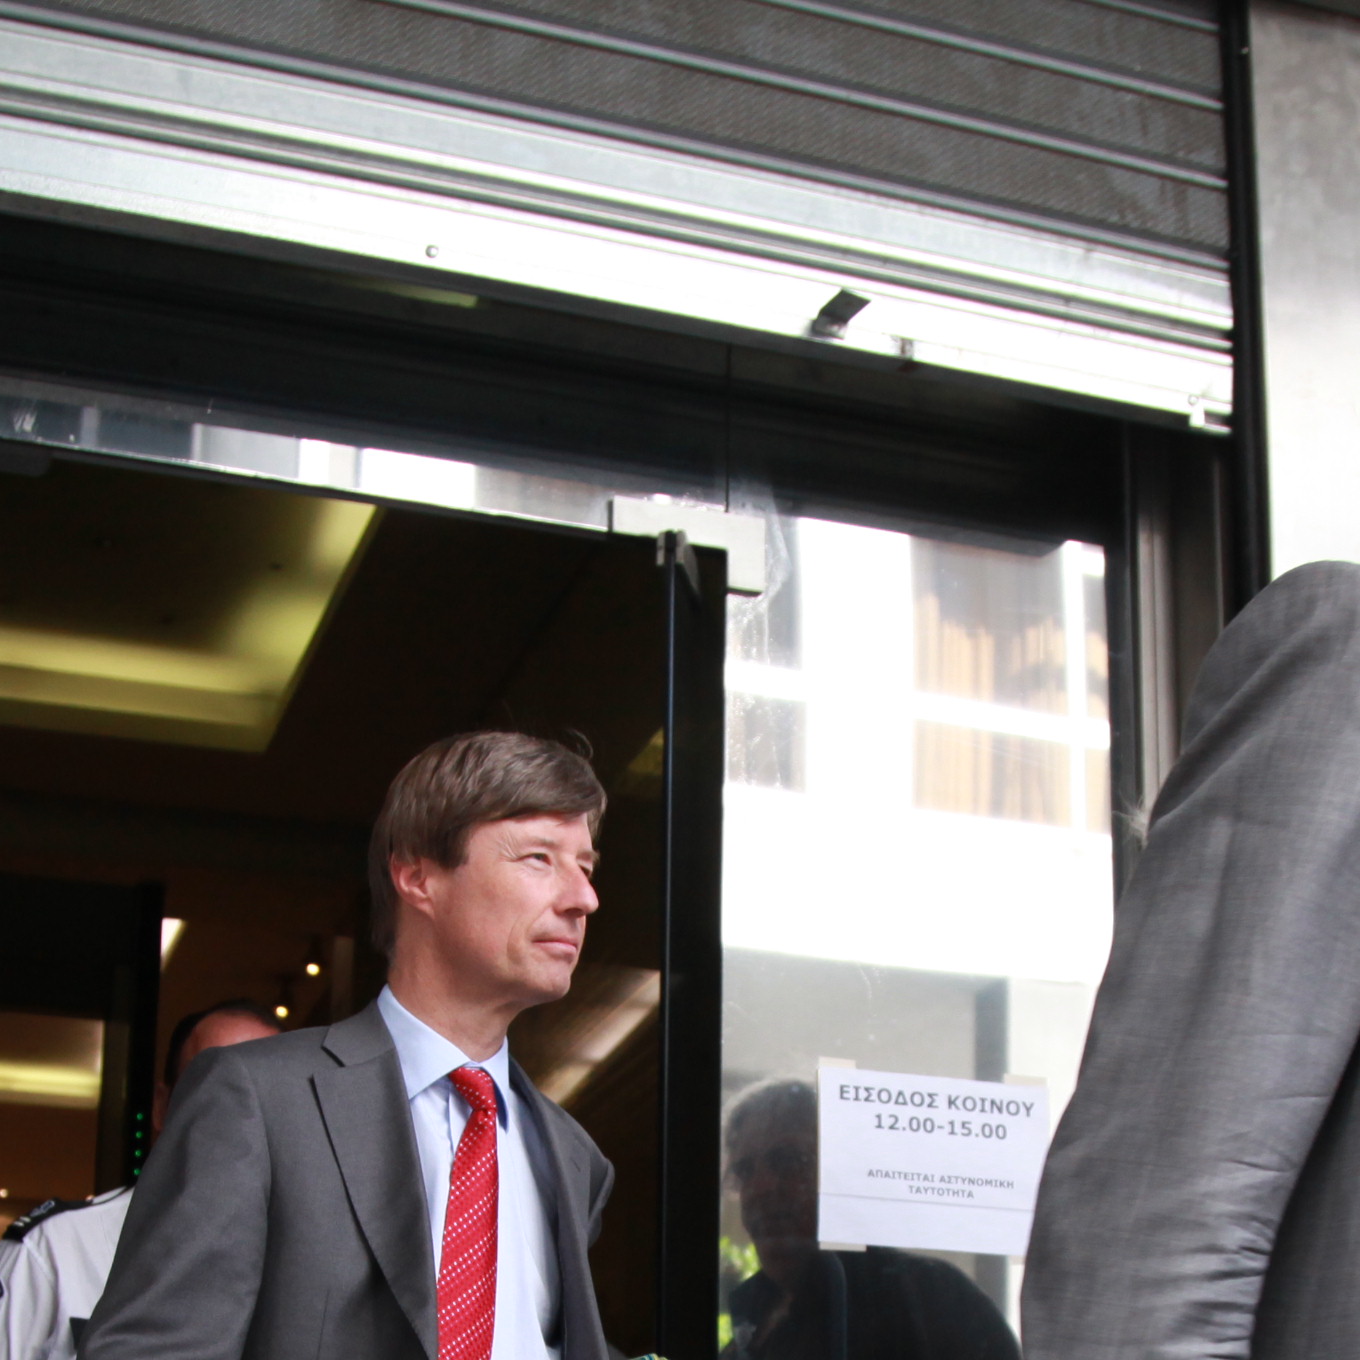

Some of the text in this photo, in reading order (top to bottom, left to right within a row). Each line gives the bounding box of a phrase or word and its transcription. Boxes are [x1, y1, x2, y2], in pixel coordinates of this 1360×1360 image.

[839, 1084, 1035, 1118] ΕΙΣΟΔΟΣ ΚΟΙΝΟΥ
[873, 1113, 1008, 1141] 12.00-15.00
[867, 1169, 1015, 1190] ΑΠΑΙΤΕΙΤΑΙ ΑΣΤΥΝΟΜΙΚΗ
[908, 1185, 975, 1200] ΤΑΥΤΟΤΗΤΑ
